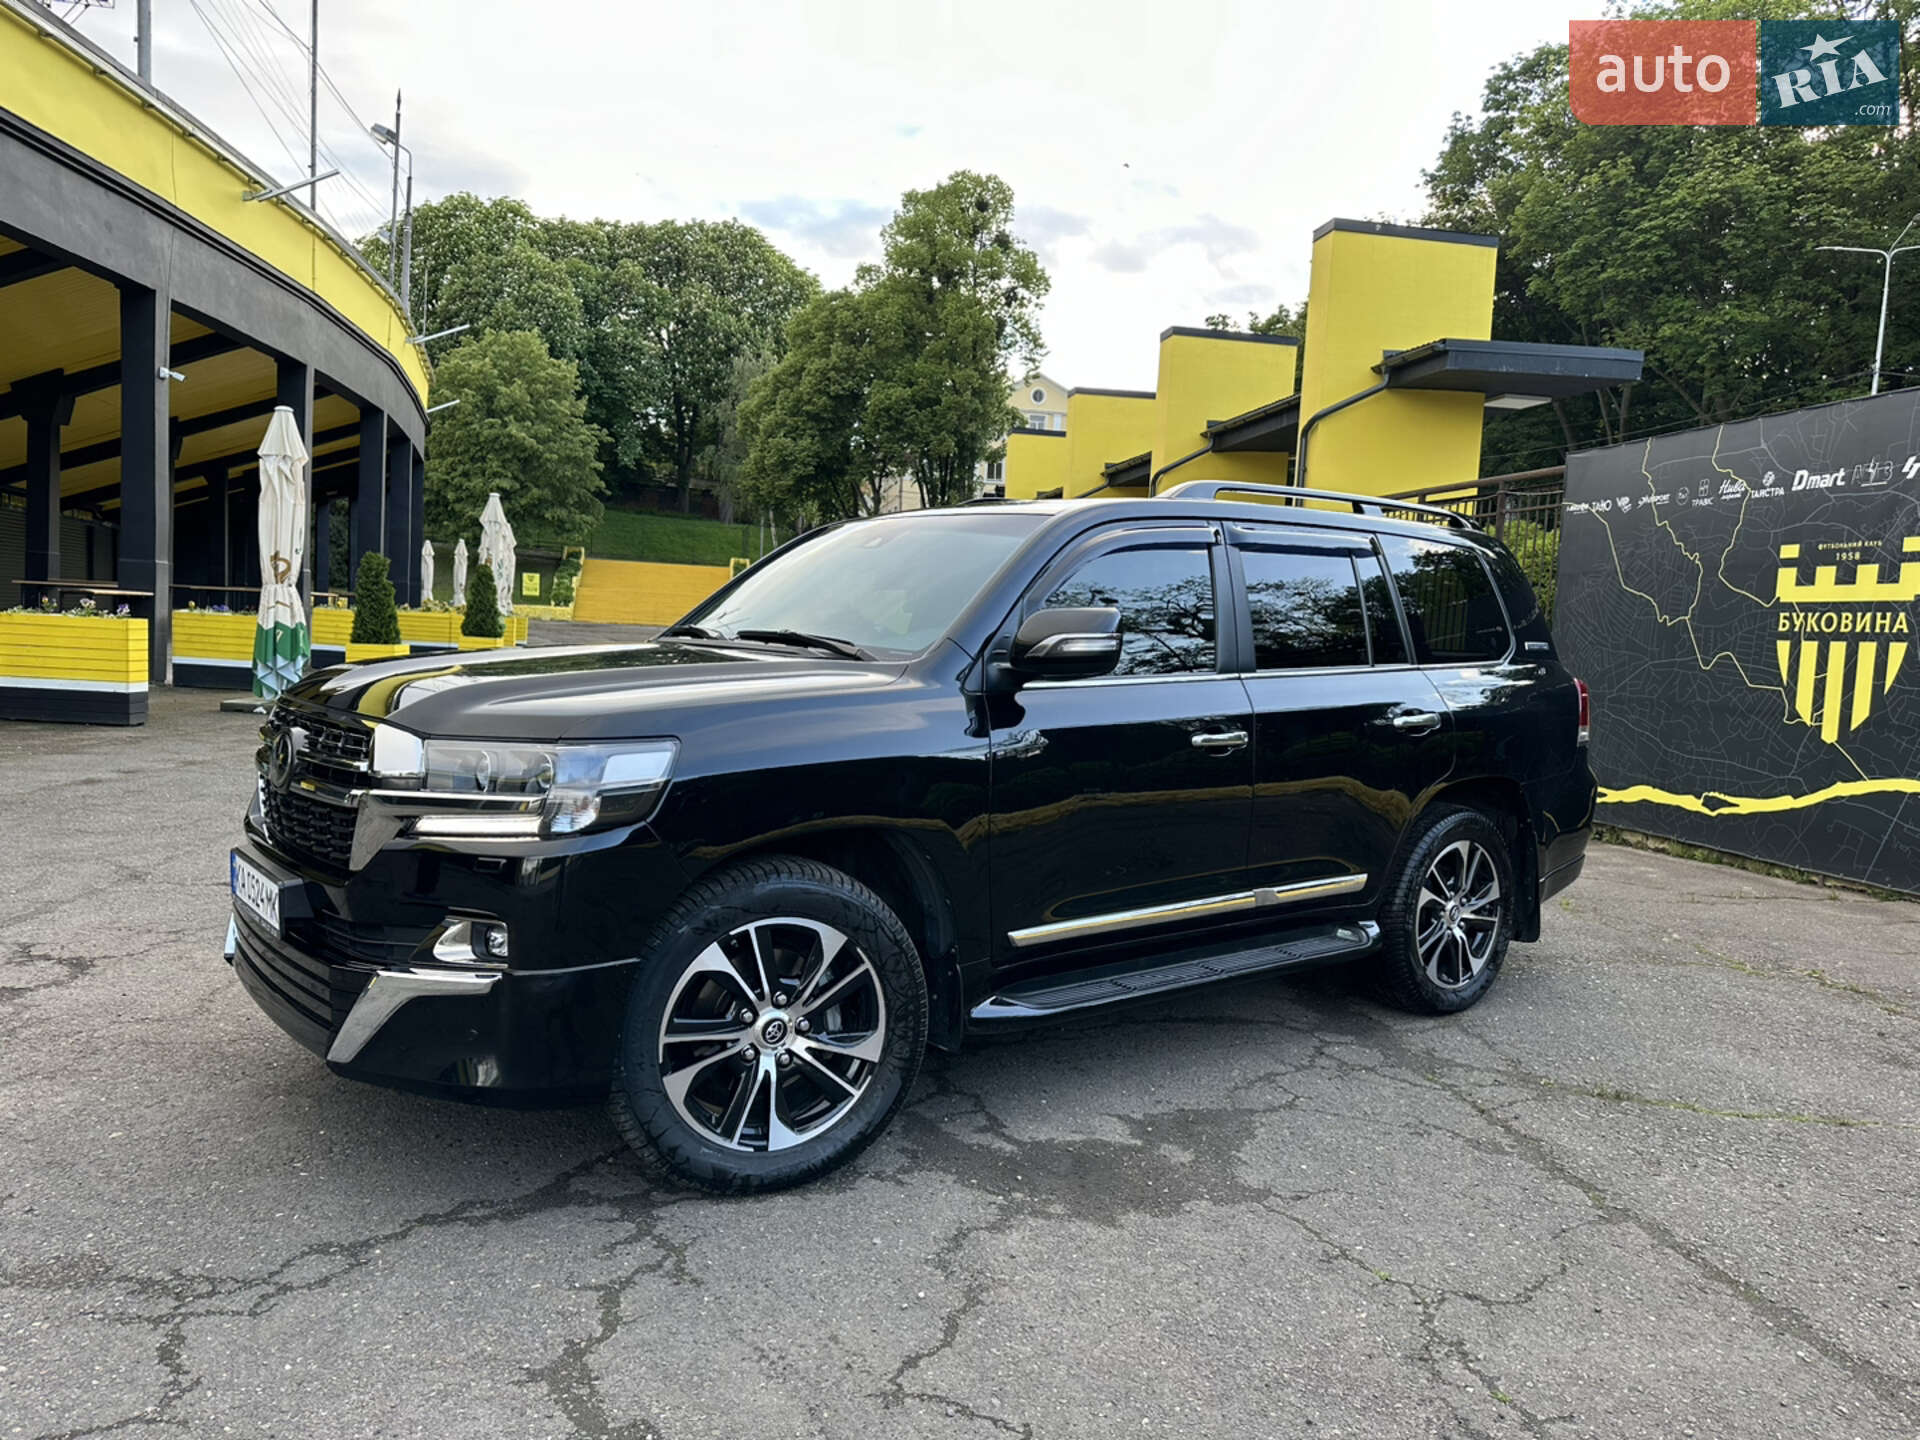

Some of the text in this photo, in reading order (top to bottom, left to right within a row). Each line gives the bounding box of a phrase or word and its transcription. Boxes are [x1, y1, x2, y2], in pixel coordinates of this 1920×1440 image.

[1792, 468, 1846, 491] Dmart
[1836, 551, 1860, 560] 1958
[1778, 612, 1909, 633] БУКОВИНА
